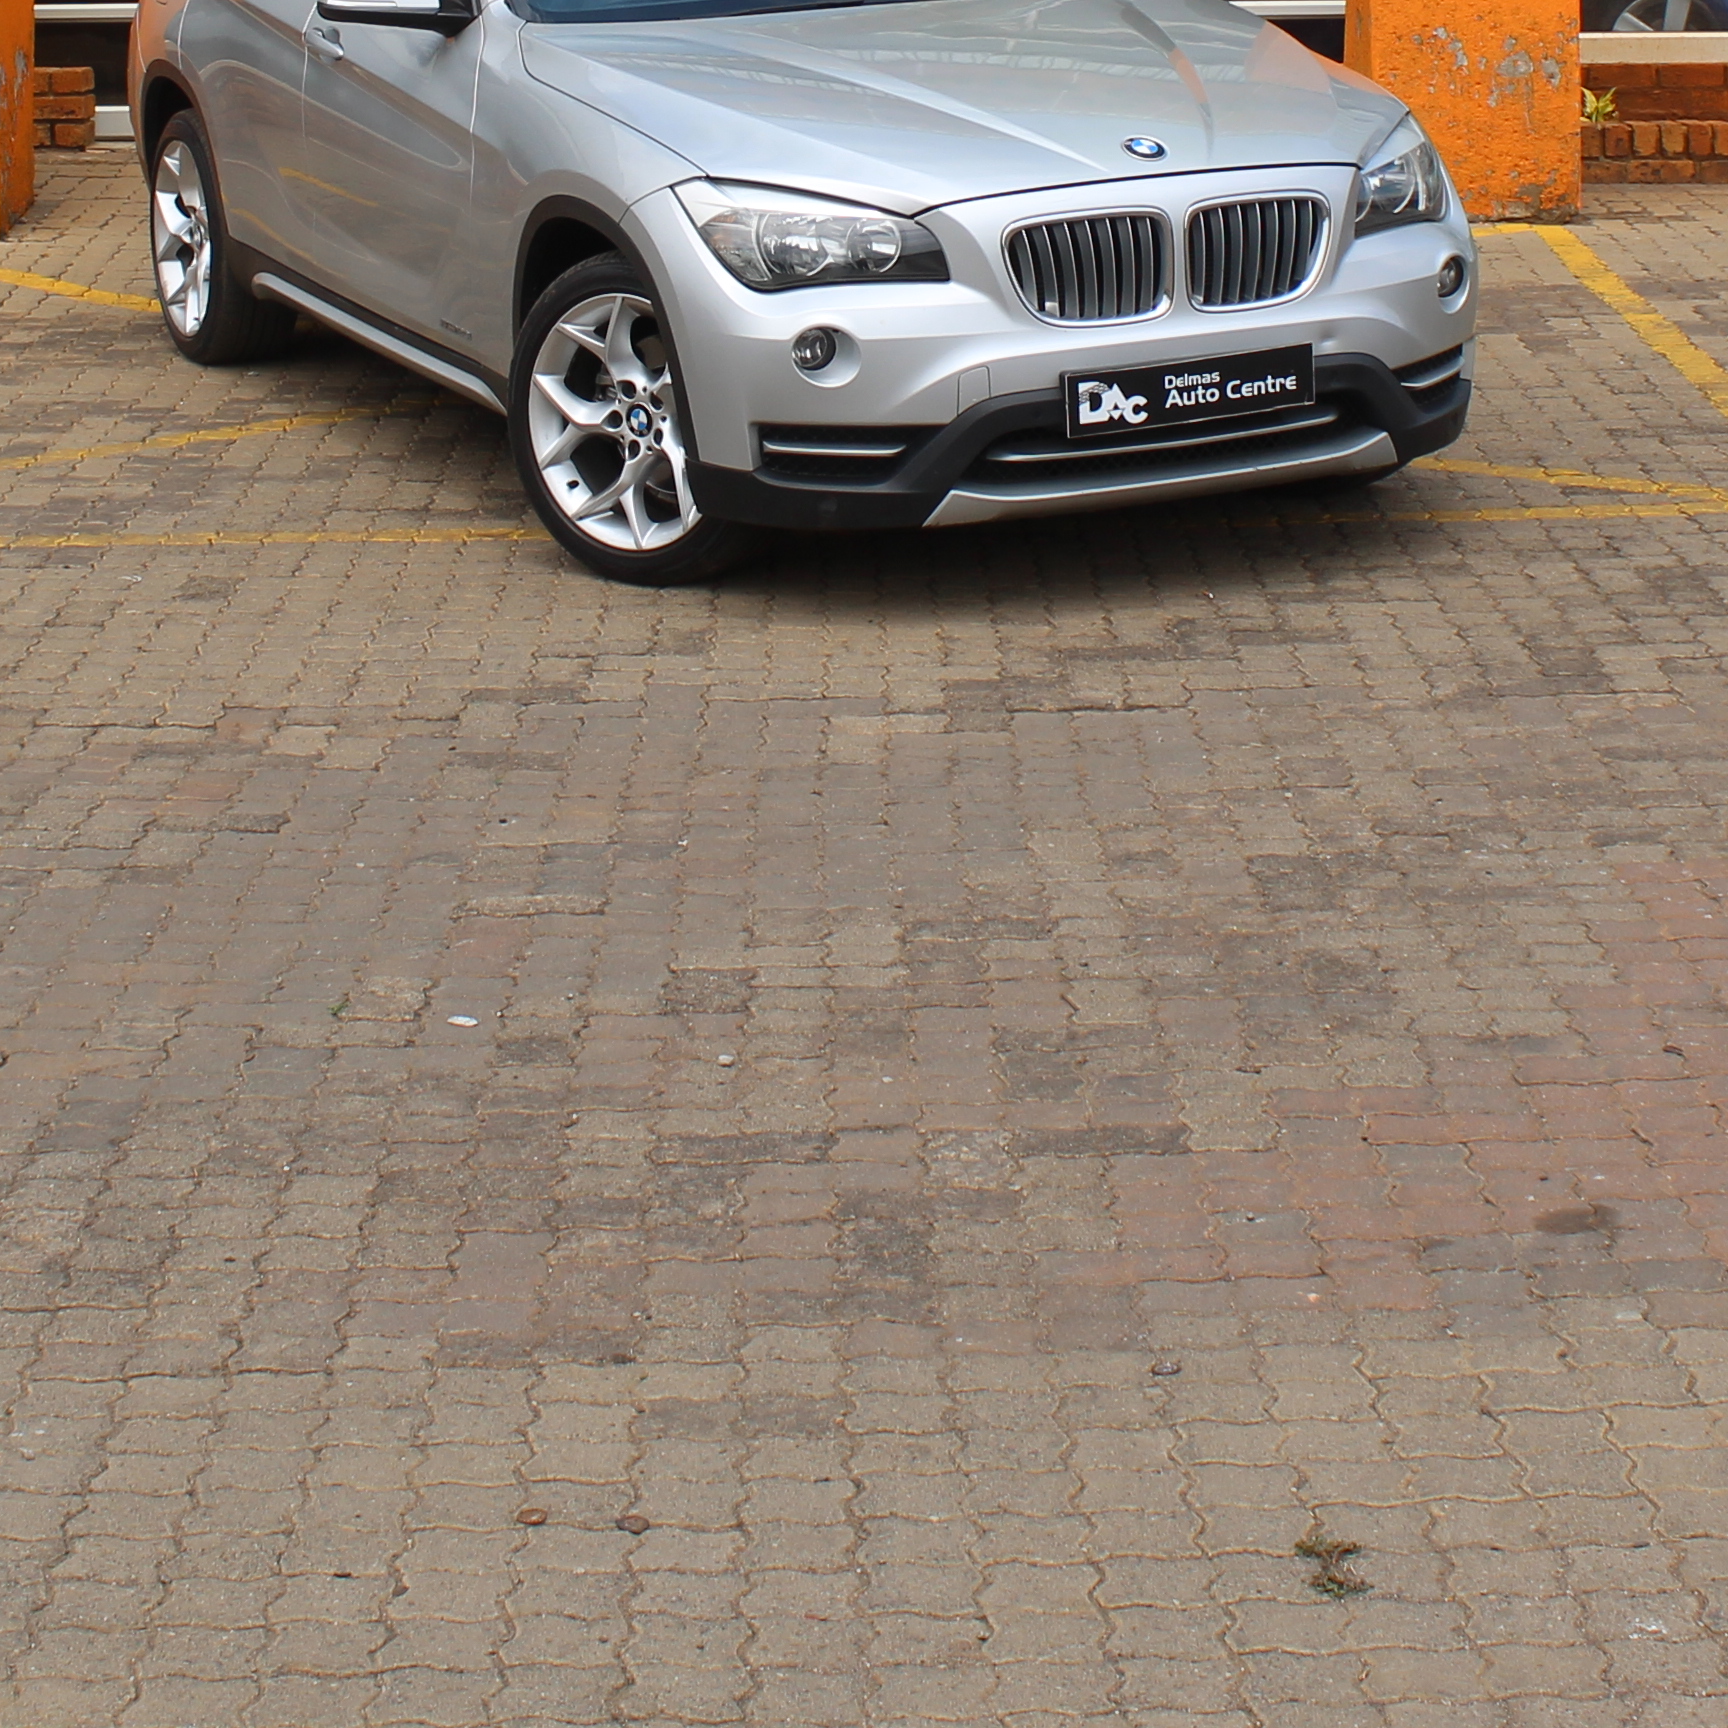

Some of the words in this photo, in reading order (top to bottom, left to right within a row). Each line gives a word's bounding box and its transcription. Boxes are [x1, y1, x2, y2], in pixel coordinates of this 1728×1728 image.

[1164, 372, 1220, 389] Delmas
[1165, 385, 1220, 408] Auto
[1226, 375, 1297, 399] Centre
[1078, 381, 1148, 425] DAC
